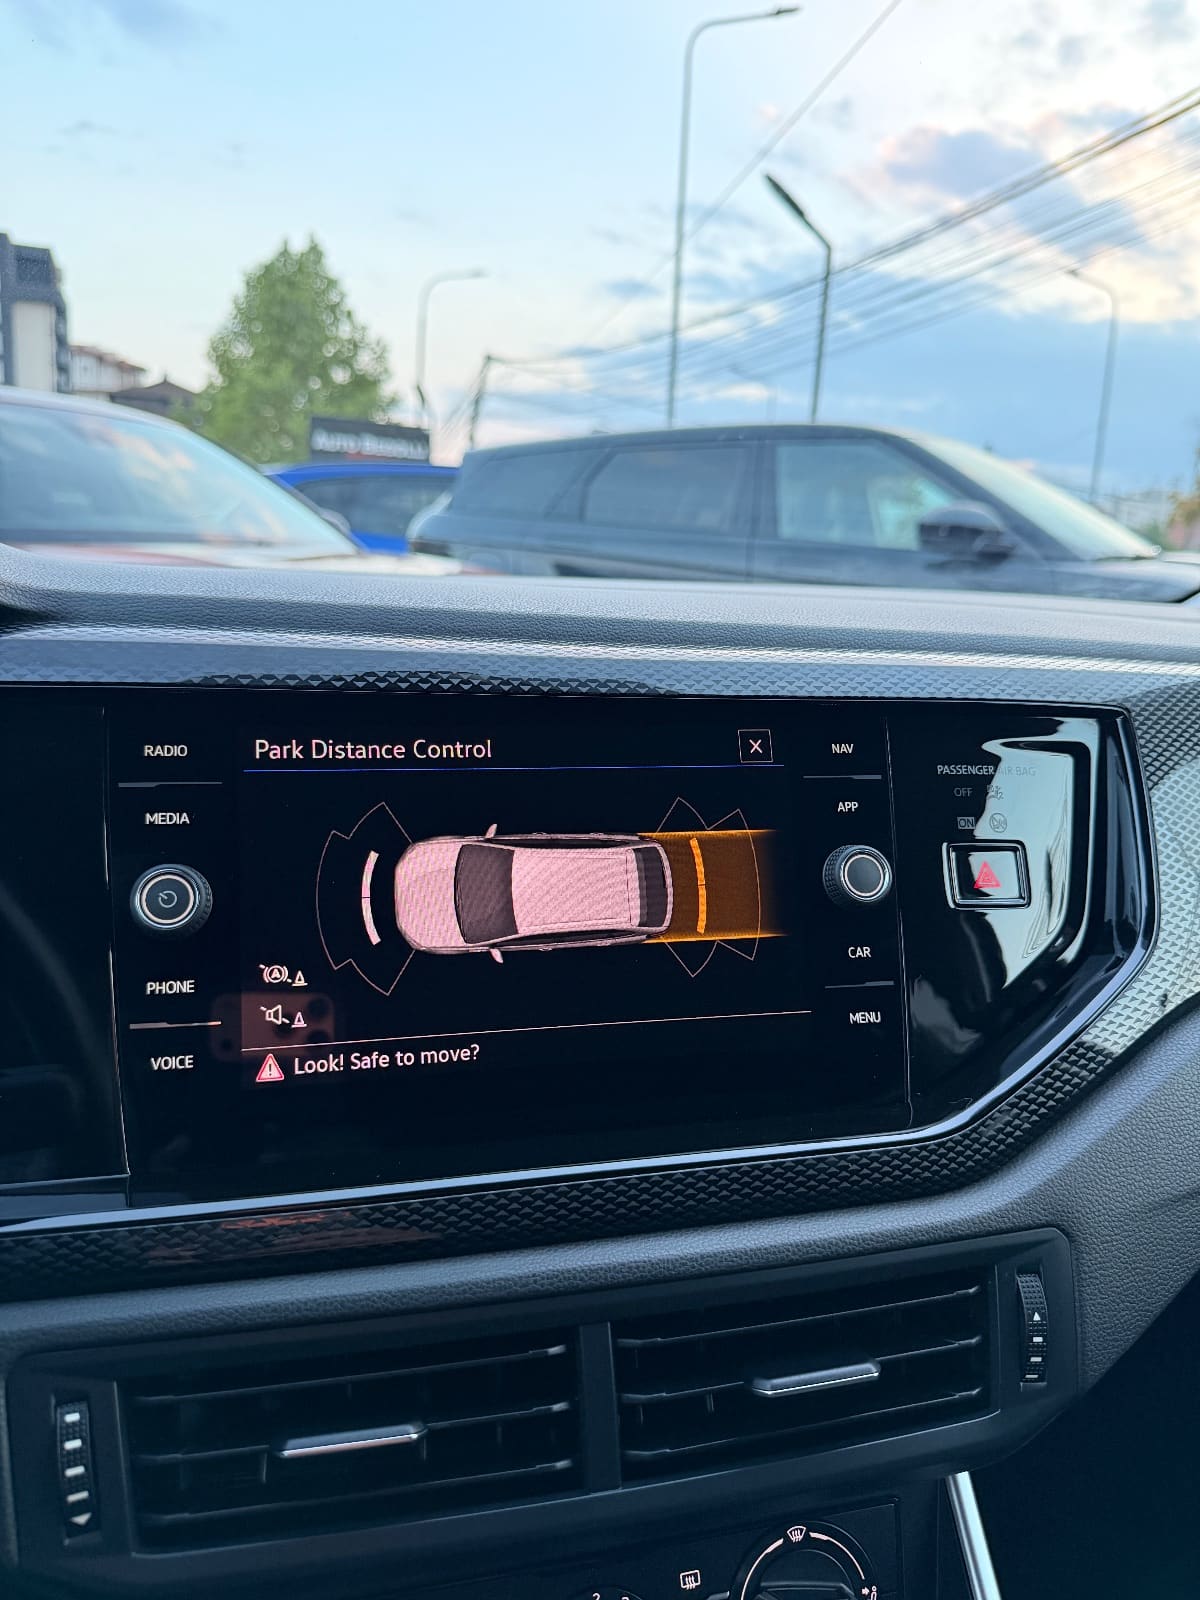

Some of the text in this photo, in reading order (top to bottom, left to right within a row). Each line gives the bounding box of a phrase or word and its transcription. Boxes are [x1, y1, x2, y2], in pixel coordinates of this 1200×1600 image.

[143, 744, 188, 757] RADIO
[255, 739, 492, 760] Park Distance Control
[831, 743, 854, 754] NAV
[936, 764, 995, 775] PASSENGER
[1015, 766, 1036, 776] BAG
[953, 787, 973, 797] OFF
[837, 801, 859, 812] APP
[145, 812, 190, 825] MEDIA
[958, 817, 975, 829] ON
[847, 946, 872, 959] CAR
[146, 979, 195, 995] PHONE
[849, 1011, 882, 1025] MENU
[150, 1054, 194, 1071] VOICE
[294, 1043, 480, 1075] Look! Safe to move?
